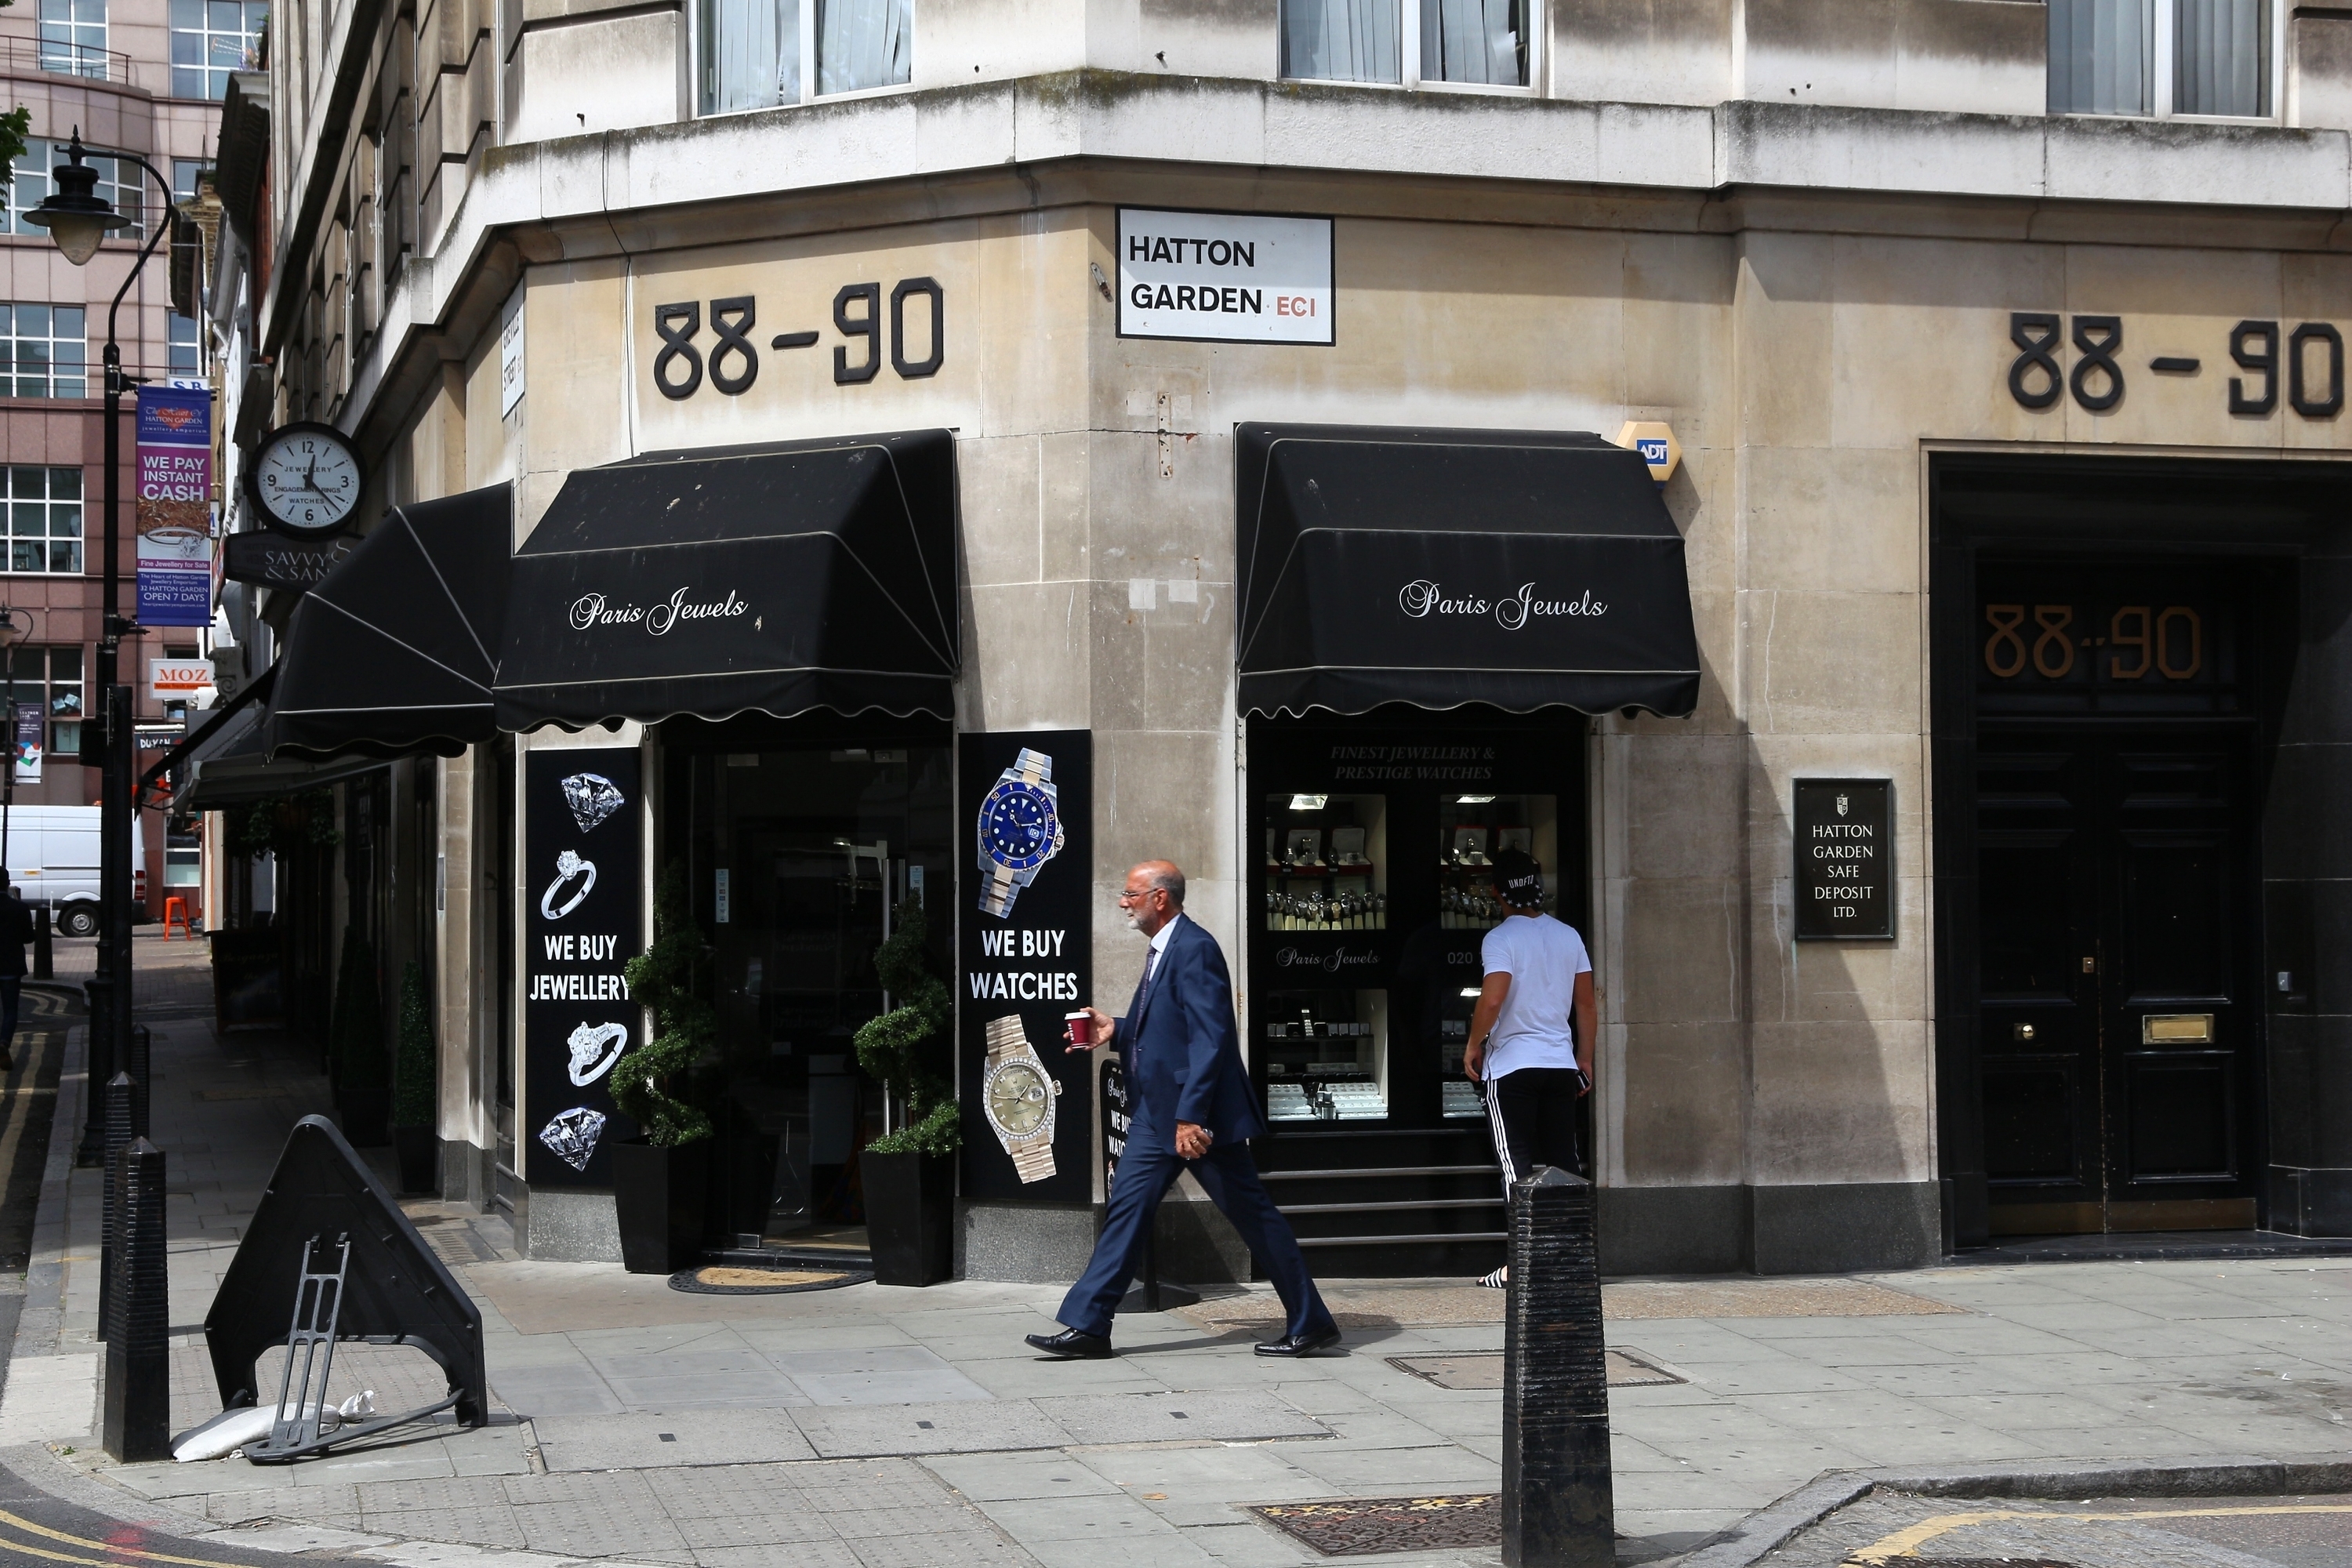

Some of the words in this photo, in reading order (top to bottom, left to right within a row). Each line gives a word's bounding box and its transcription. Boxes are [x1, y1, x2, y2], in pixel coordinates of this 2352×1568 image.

[1129, 235, 1255, 267] HATTON
[1131, 283, 1261, 314] GARDEN
[503, 355, 516, 391] STREET
[302, 441, 314, 453] 12
[143, 456, 170, 469] WE
[174, 457, 205, 470] PAY
[143, 470, 204, 484] INSTANT
[267, 474, 277, 486] 9
[340, 476, 349, 488] 3
[143, 484, 204, 502] CASH
[305, 509, 314, 521] 6
[265, 550, 329, 567] SAVVY
[265, 566, 285, 580] &
[289, 566, 330, 581] SAN
[143, 592, 171, 601] OPEN
[173, 593, 179, 601] 7
[181, 593, 205, 602] DAYS
[1399, 579, 1491, 618] Paris
[1495, 582, 1607, 630] Jewels
[569, 593, 645, 630] Paris
[646, 586, 749, 636] Jewels
[158, 669, 208, 682] MOZ
[1330, 746, 1388, 759] FINEST
[1387, 746, 1482, 762] JEWELLERY
[1483, 746, 1496, 760] &
[1334, 766, 1413, 779] PRESTIGE
[1416, 767, 1493, 779] WATCHES
[1813, 825, 1873, 838] HATTON
[1813, 846, 1873, 858] GARDEN
[1828, 865, 1859, 878] SAFE
[1814, 887, 1874, 899] DEPOSIT
[1833, 906, 1857, 917] LTD.
[544, 935, 574, 960] WE
[580, 935, 618, 960] BUY
[982, 930, 1015, 956] WE
[1022, 930, 1065, 957] BUY
[1276, 946, 1322, 967] Paris
[1323, 946, 1380, 972] Jewels
[1447, 952, 1473, 964] 020
[529, 975, 629, 1000] JEWELLERY
[970, 972, 1078, 1000] WATCHES
[1111, 1109, 1120, 1130] WE
[1108, 1134, 1126, 1158] WATC
